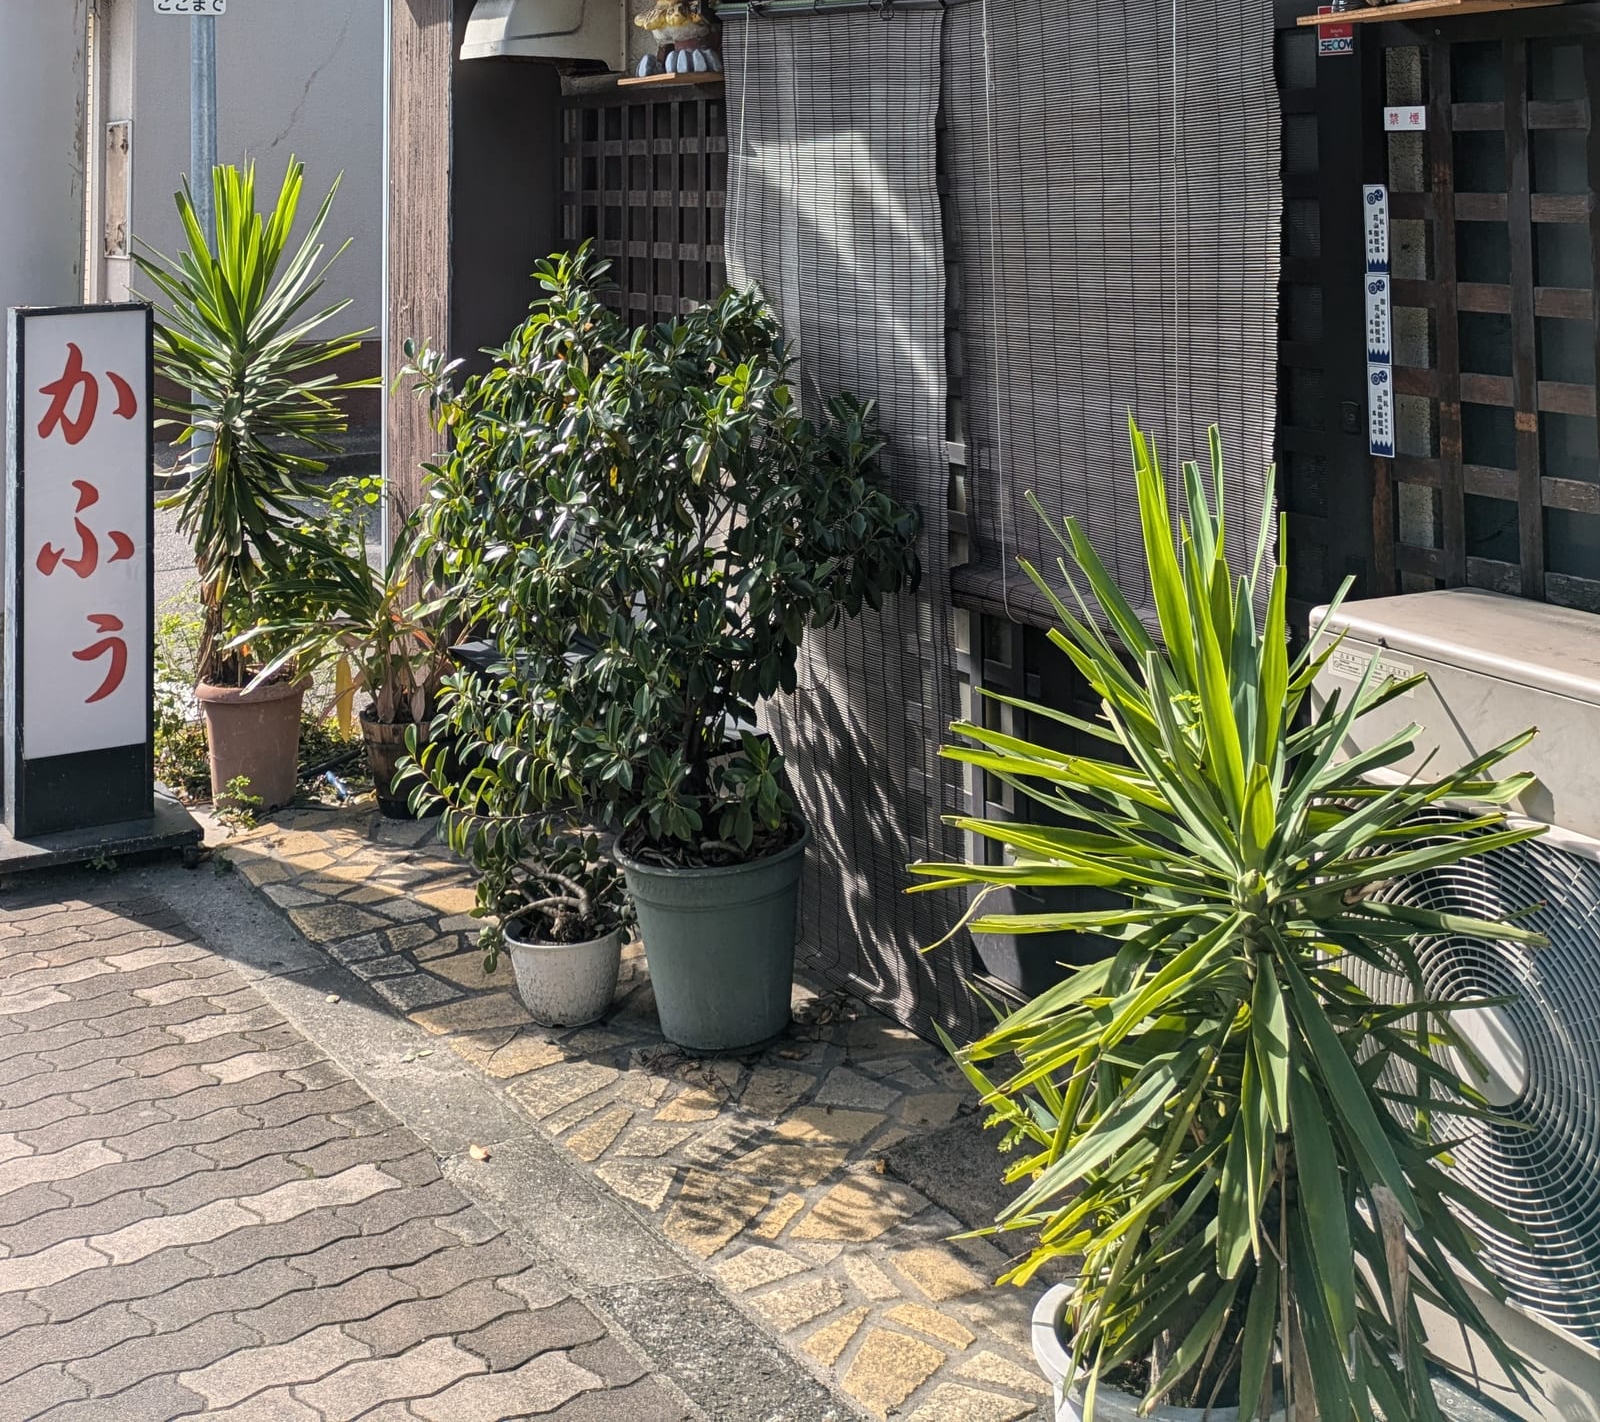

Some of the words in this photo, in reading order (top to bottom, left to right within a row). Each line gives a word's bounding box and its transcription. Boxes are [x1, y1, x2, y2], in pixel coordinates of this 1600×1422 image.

[1321, 39, 1353, 51] SECOM
[1389, 112, 1420, 126] 禁煙
[37, 341, 138, 705] かふう
